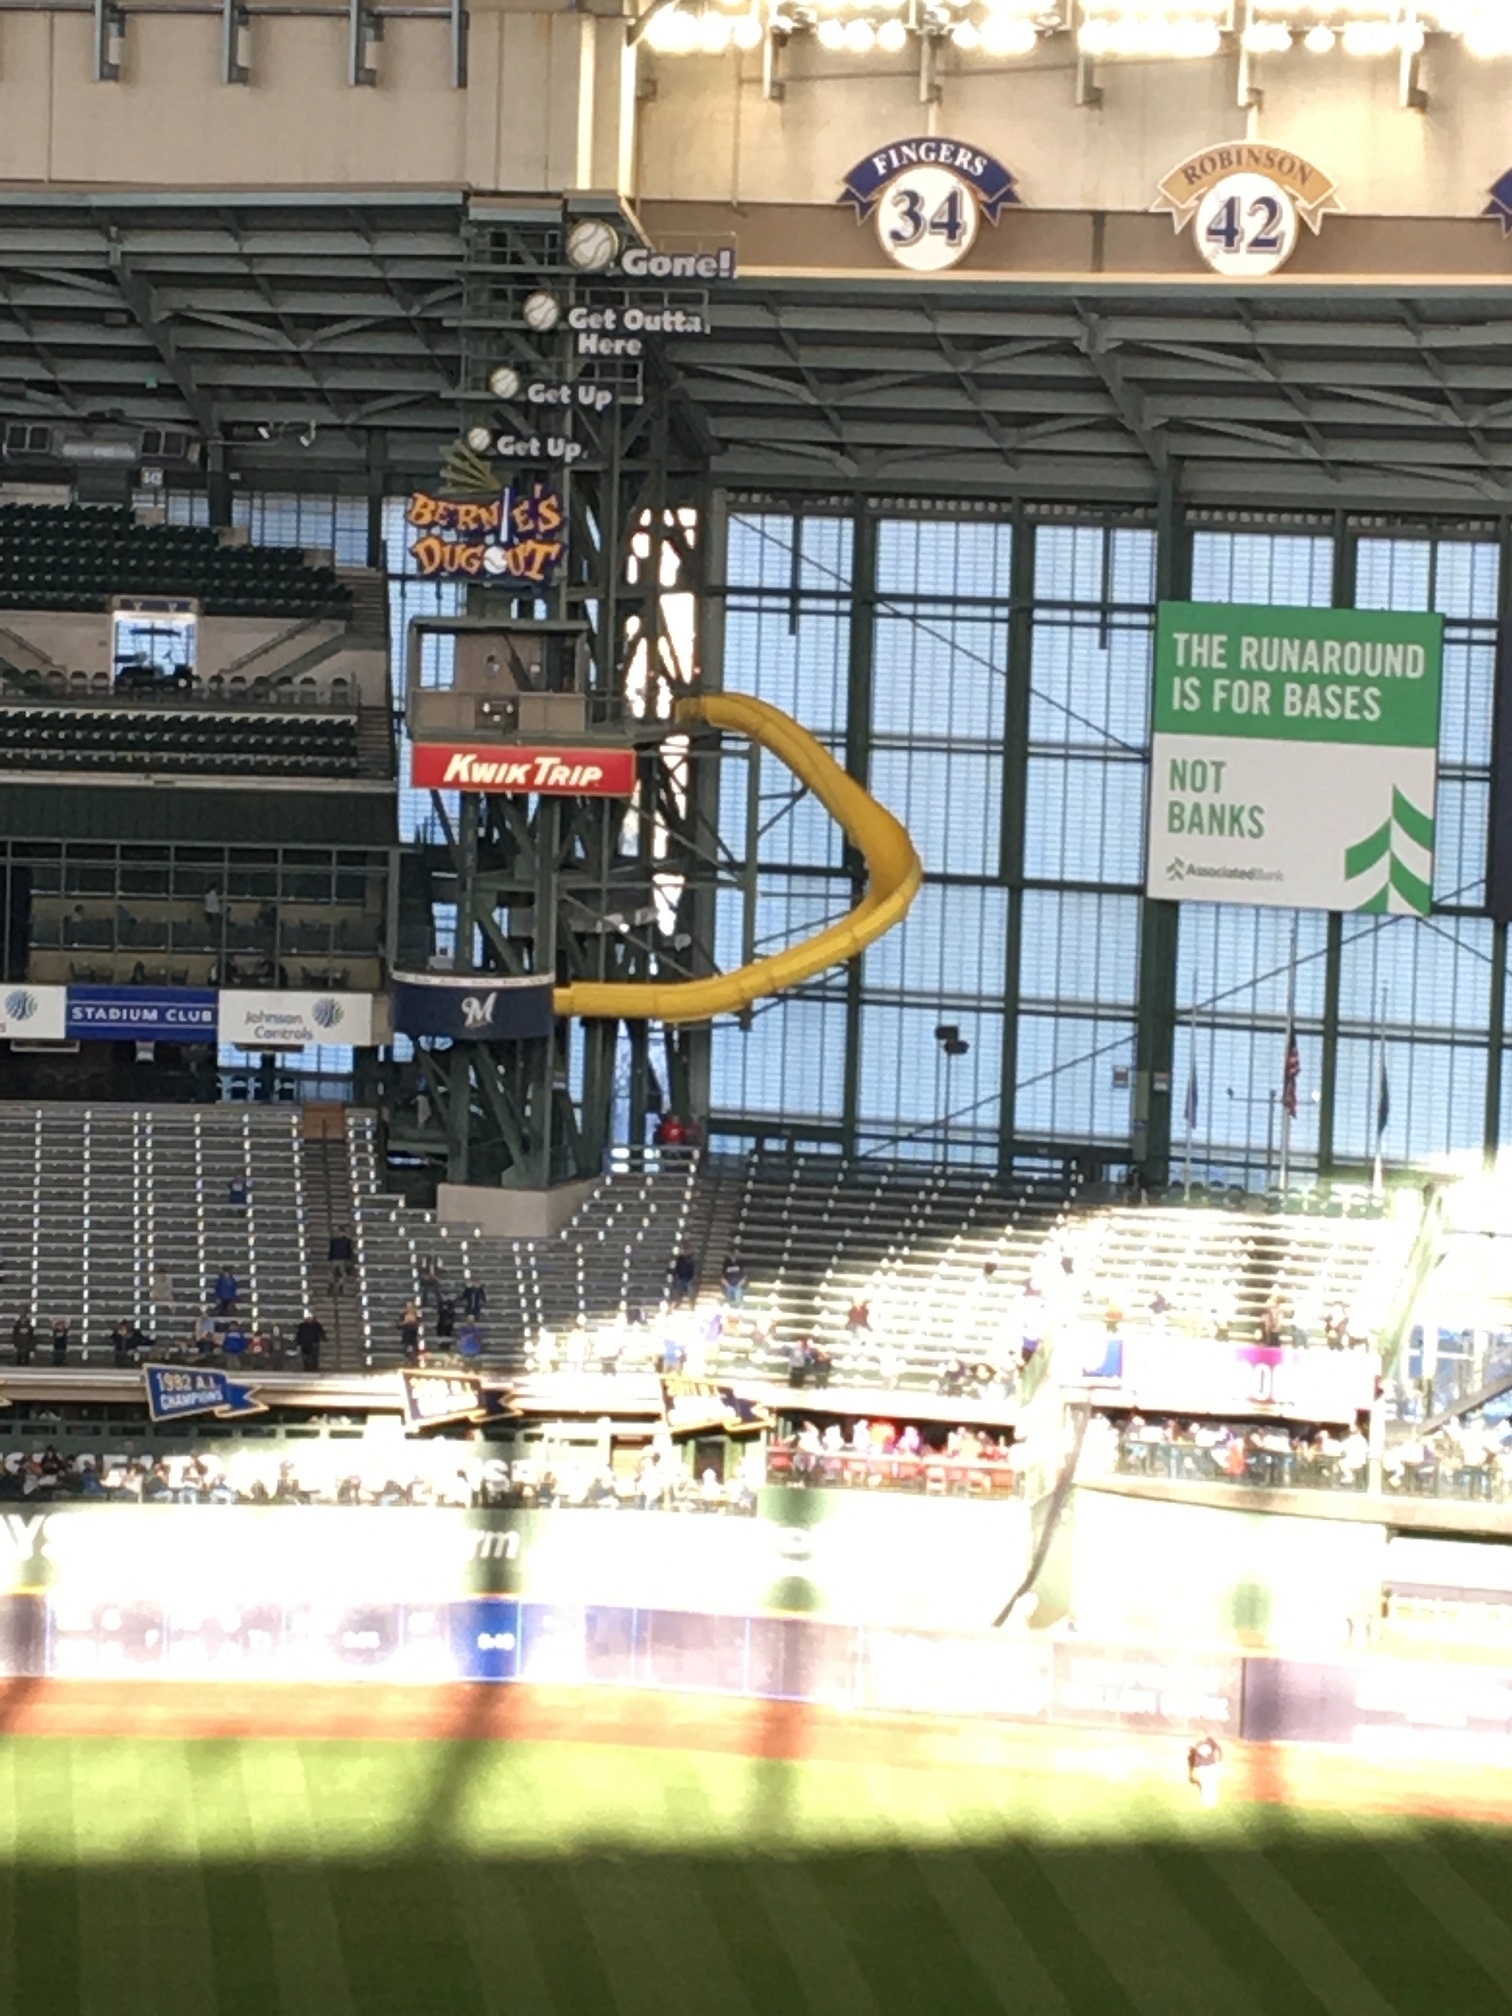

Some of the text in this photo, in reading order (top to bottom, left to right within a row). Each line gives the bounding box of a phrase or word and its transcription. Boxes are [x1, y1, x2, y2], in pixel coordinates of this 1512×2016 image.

[872, 142, 987, 176] FINGERS
[1181, 148, 1313, 186] ROBINSON
[889, 185, 967, 247] 34
[1205, 196, 1285, 254] 42
[621, 249, 734, 277] Gone!
[568, 308, 702, 333] Get Outta
[578, 333, 642, 356] Here
[528, 383, 612, 410] Get Up
[497, 436, 581, 461] Get Up
[408, 484, 562, 542] BERNIE'S
[412, 537, 561, 581] DUGOUT
[1173, 633, 1425, 679] THE RUNAROUND
[1172, 676, 1382, 722] IS FOR BASES
[1169, 758, 1227, 794] NOT
[1168, 800, 1265, 840] BANKS
[72, 1006, 212, 1022] STADIUM CLUB
[245, 1009, 303, 1025] Johnson
[254, 1025, 313, 1041] Controls
